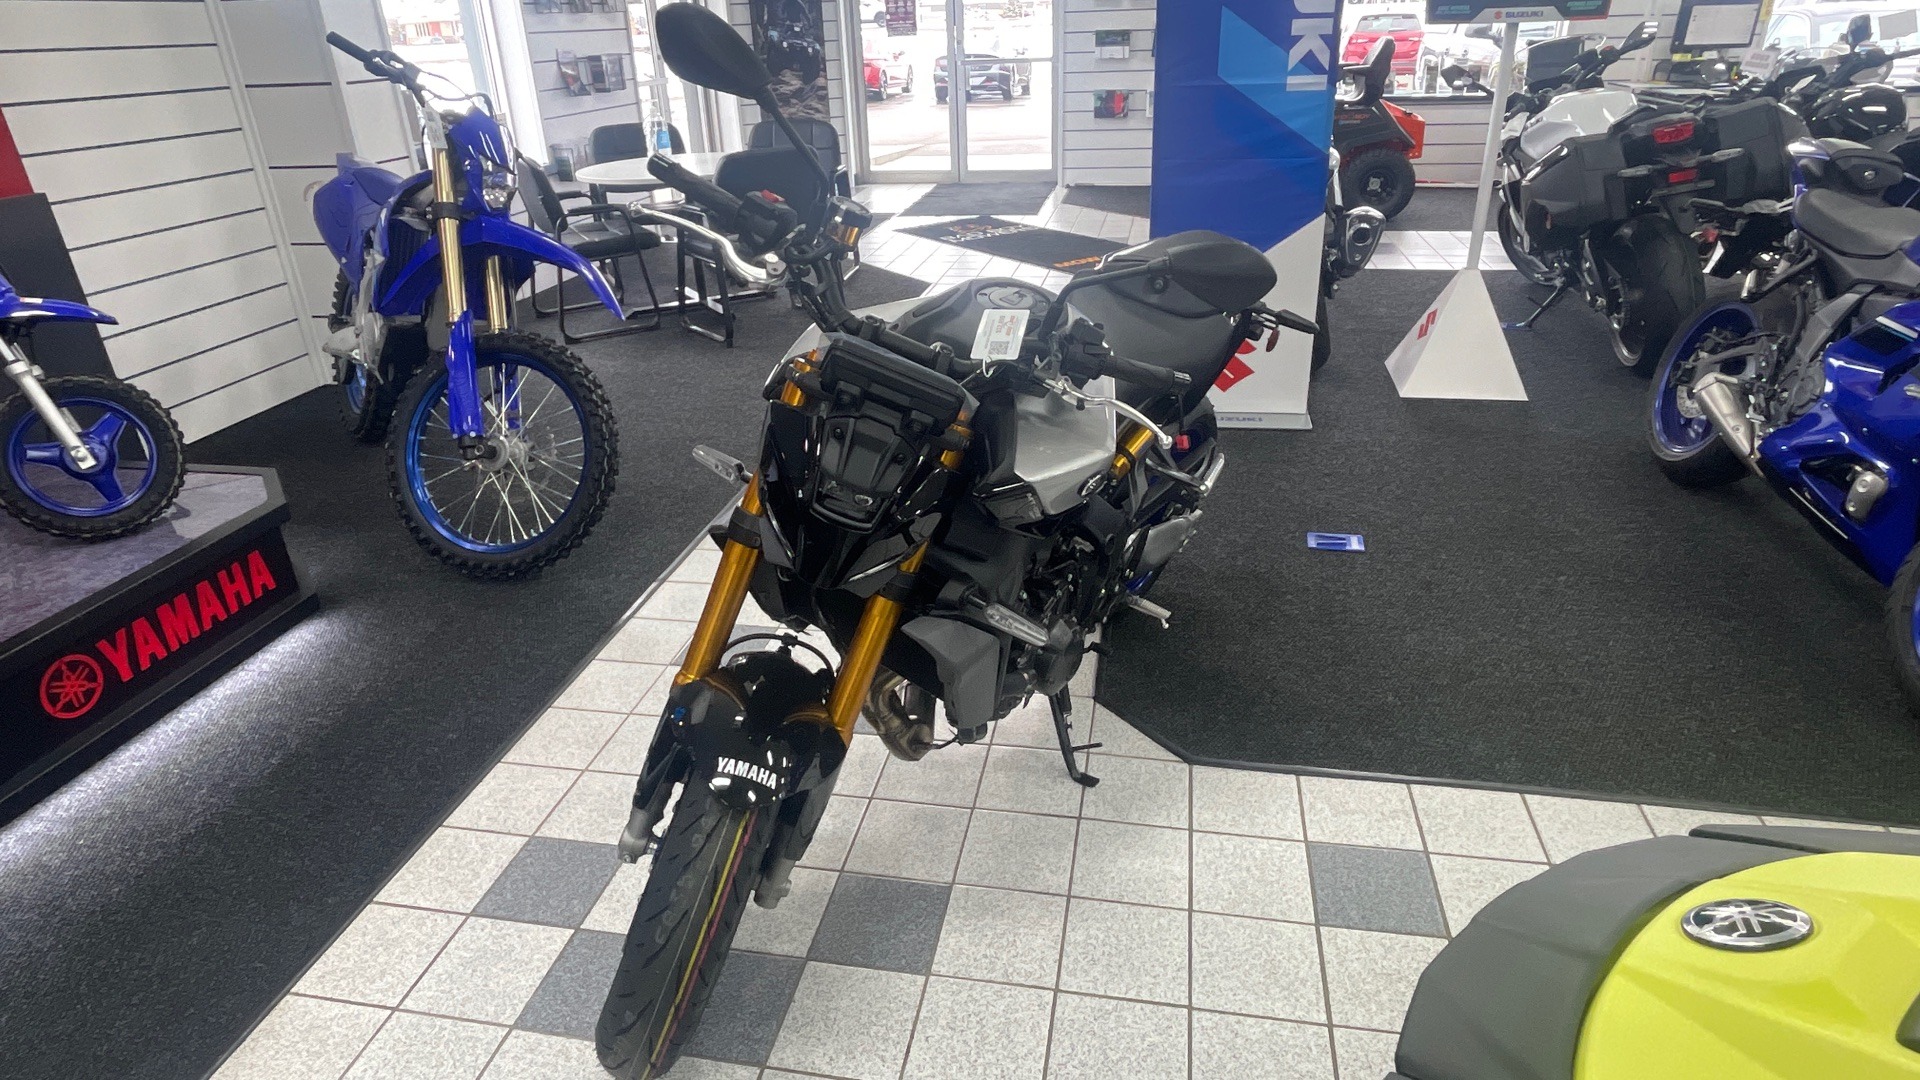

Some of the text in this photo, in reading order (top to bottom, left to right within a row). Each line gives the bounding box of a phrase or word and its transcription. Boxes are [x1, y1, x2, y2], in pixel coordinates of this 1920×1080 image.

[1505, 10, 1544, 18] SUZUKI
[95, 550, 276, 682] YAMAHA
[717, 757, 777, 789] YAMAHA
